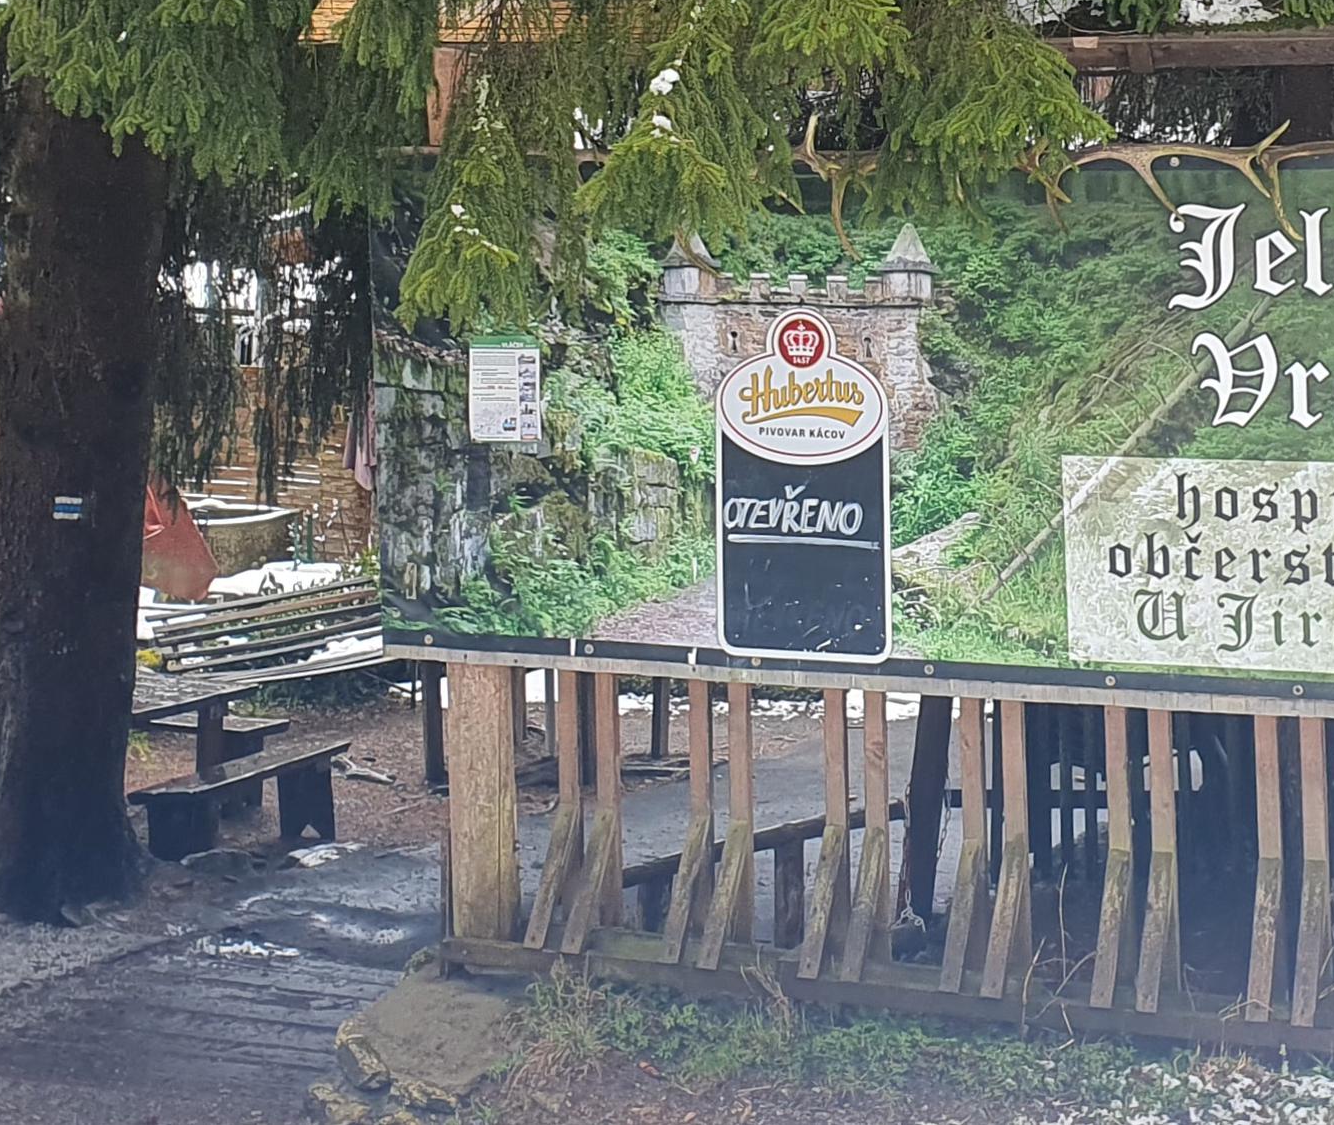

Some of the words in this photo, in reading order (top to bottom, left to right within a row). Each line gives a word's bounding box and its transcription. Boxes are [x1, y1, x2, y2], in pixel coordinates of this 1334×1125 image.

[740, 365, 864, 418] Hubertus
[758, 426, 806, 439] PIVOVAR
[809, 426, 846, 440] KÁCOV
[723, 485, 863, 535] OTEVŘENO
[1133, 589, 1188, 643] U
